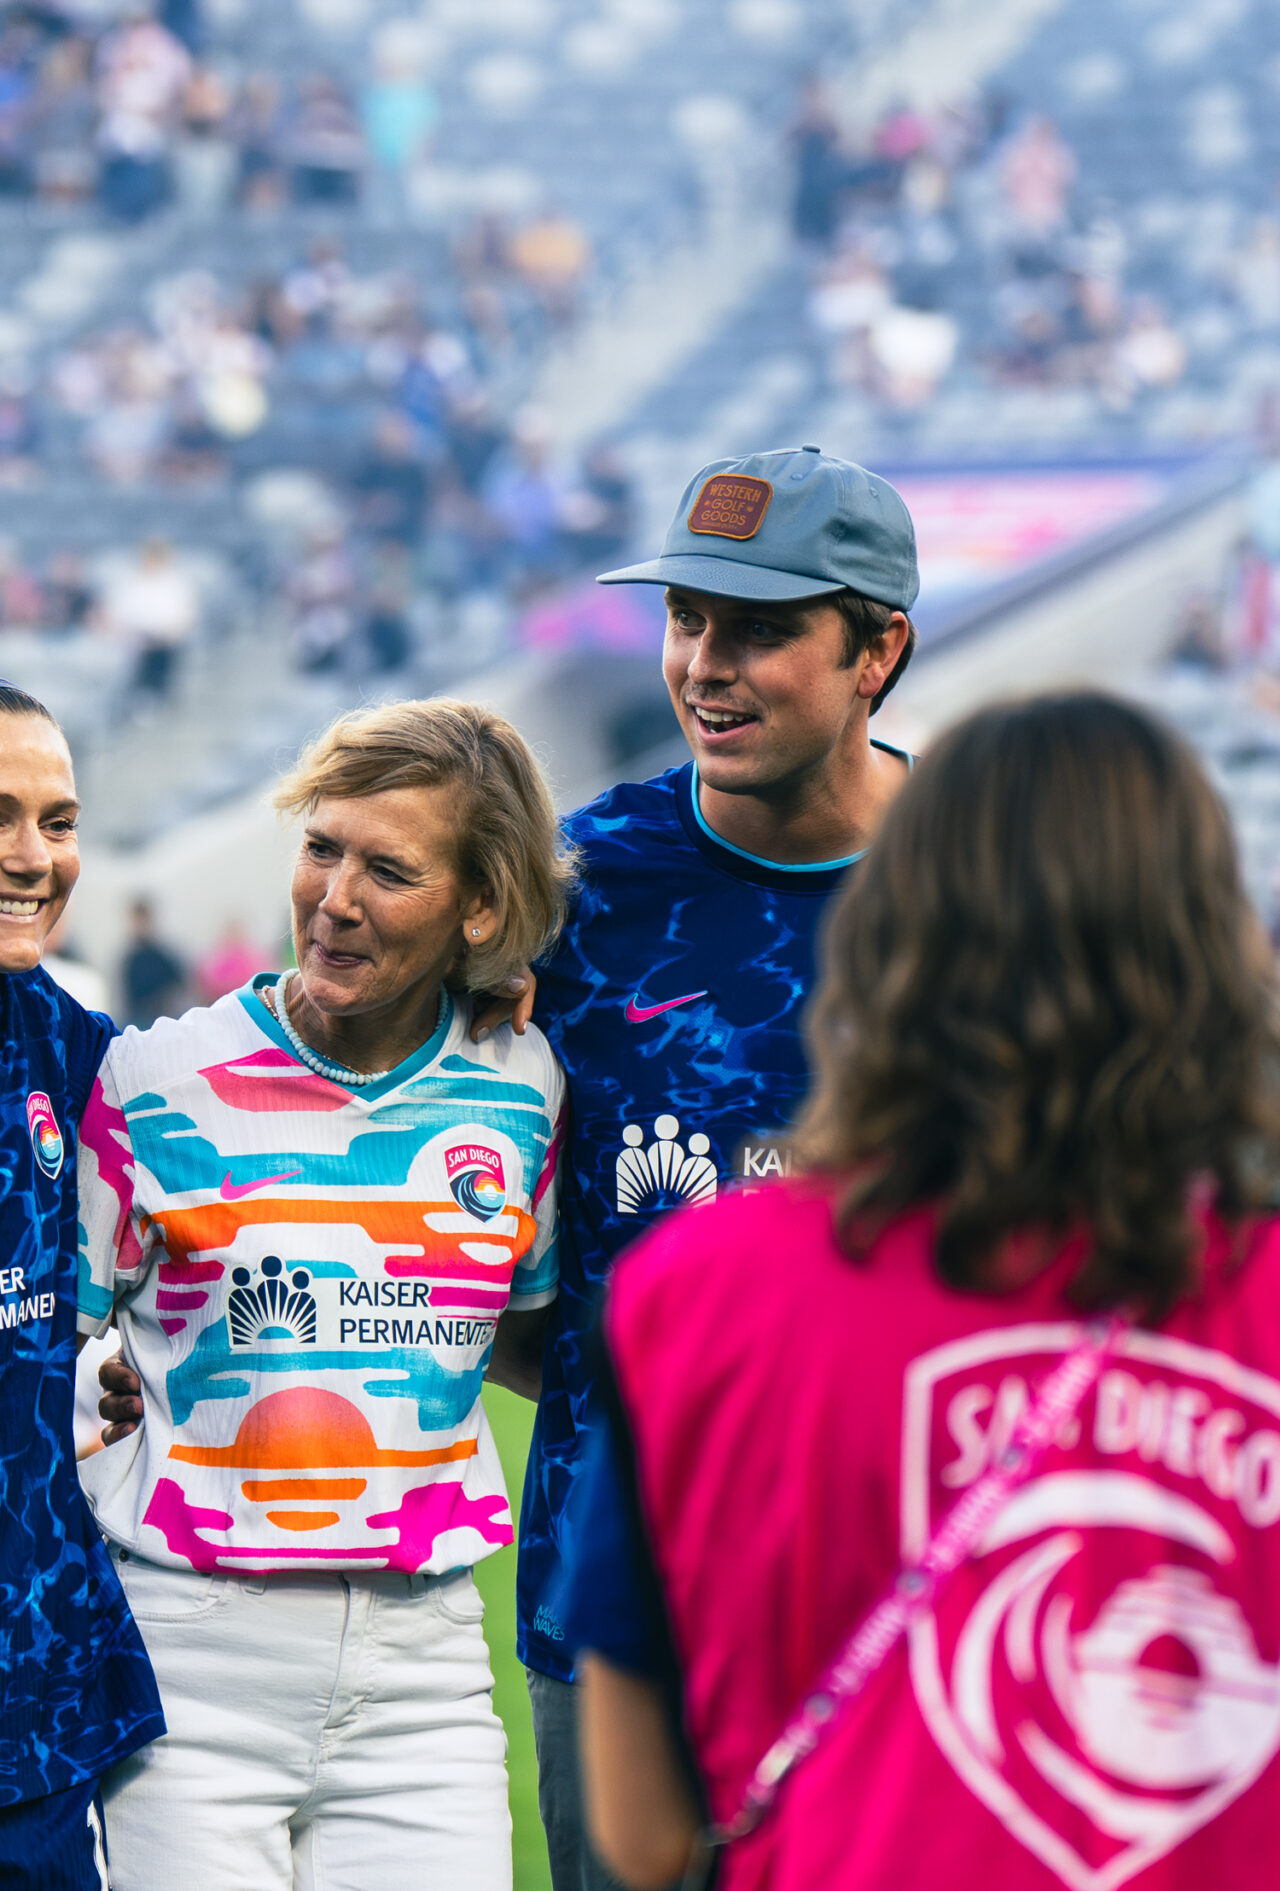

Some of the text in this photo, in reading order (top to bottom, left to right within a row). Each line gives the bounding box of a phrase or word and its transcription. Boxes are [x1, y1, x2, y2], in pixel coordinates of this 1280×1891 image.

[709, 484, 761, 502] WESTERN
[711, 499, 746, 512] GOLF
[701, 510, 746, 526] GOODS
[448, 1149, 499, 1168] SAN DIEGO
[744, 1147, 792, 1177] KAI
[339, 1281, 430, 1307] KAISER
[1092, 1368, 1280, 1529] DIEGO
[533, 1617, 565, 1640] WAVES
